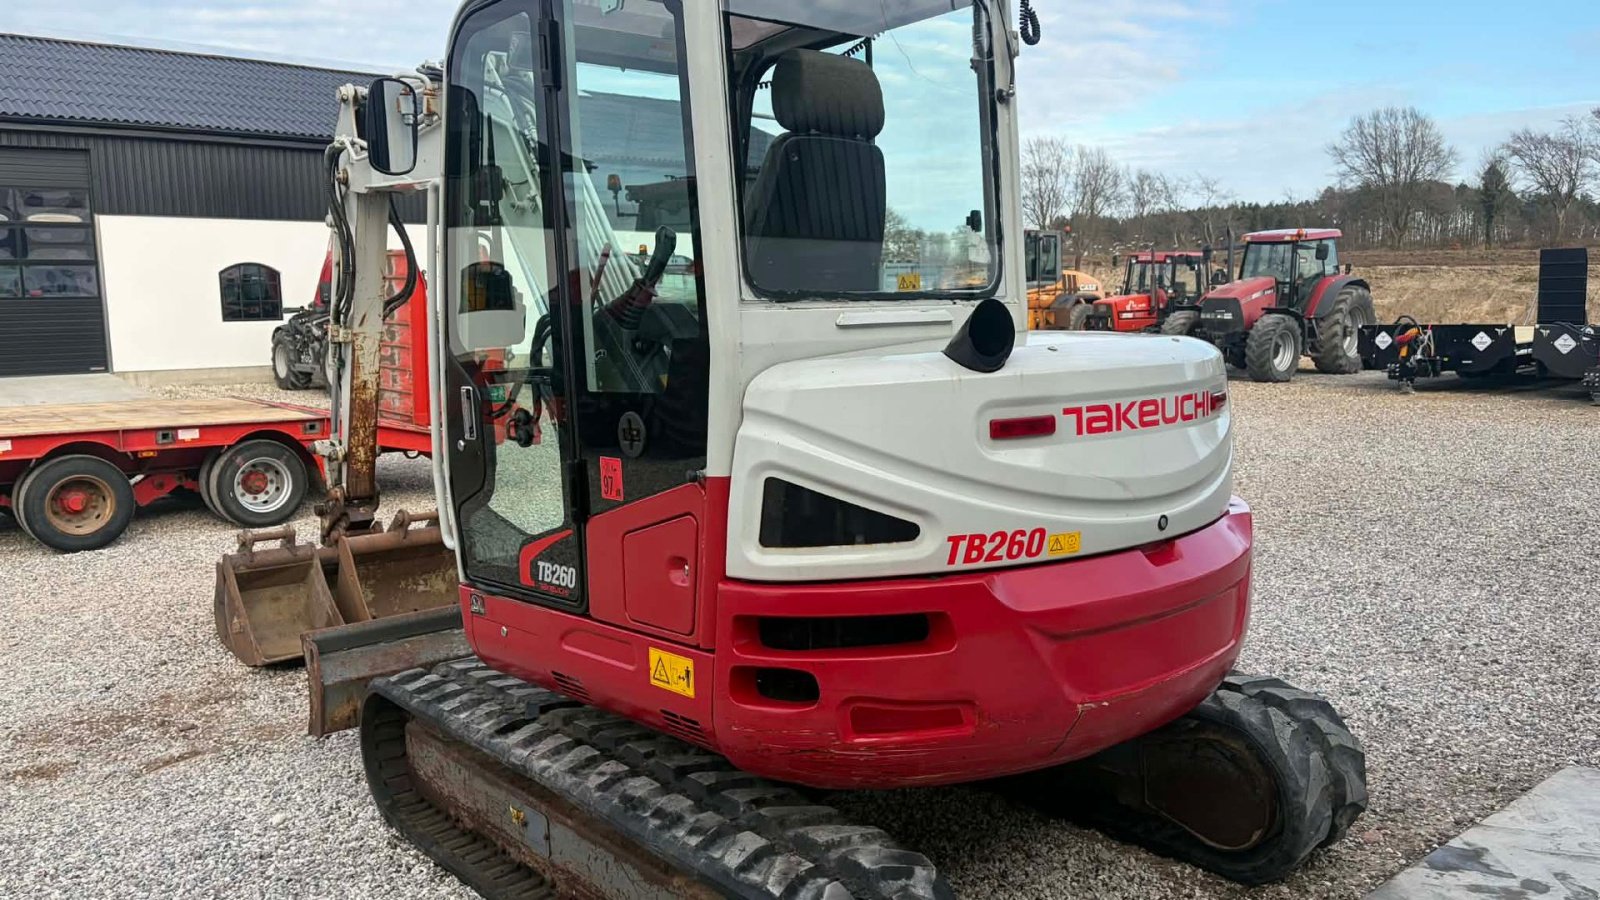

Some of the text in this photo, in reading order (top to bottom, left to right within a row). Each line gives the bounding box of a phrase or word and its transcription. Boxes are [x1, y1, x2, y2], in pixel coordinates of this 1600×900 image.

[603, 475, 613, 496] 97
[946, 527, 1047, 565] TB260
[537, 560, 576, 588] TB260
